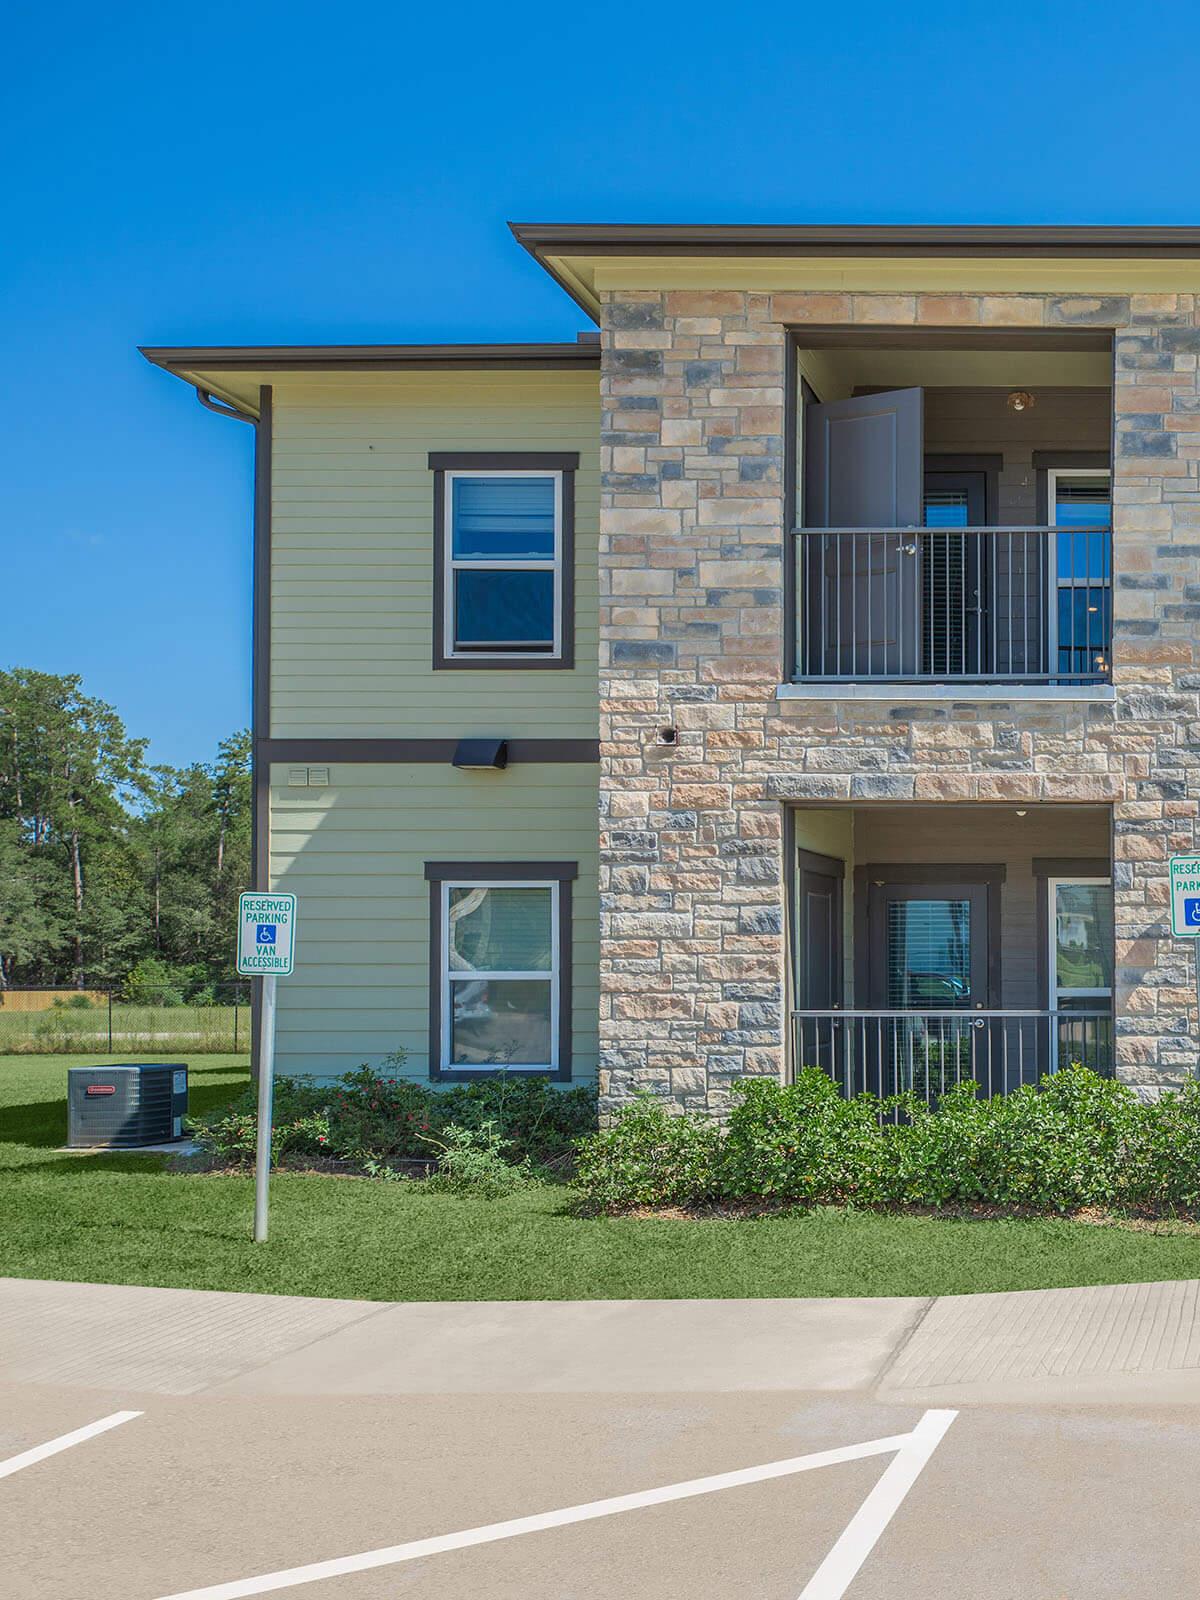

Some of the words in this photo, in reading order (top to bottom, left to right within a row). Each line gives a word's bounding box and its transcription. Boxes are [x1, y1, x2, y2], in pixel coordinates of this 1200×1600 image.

[243, 900, 291, 912] RESERVED
[246, 912, 288, 924] PARKING
[256, 945, 276, 956] VAN
[242, 956, 289, 968] ACCESSIBLE
